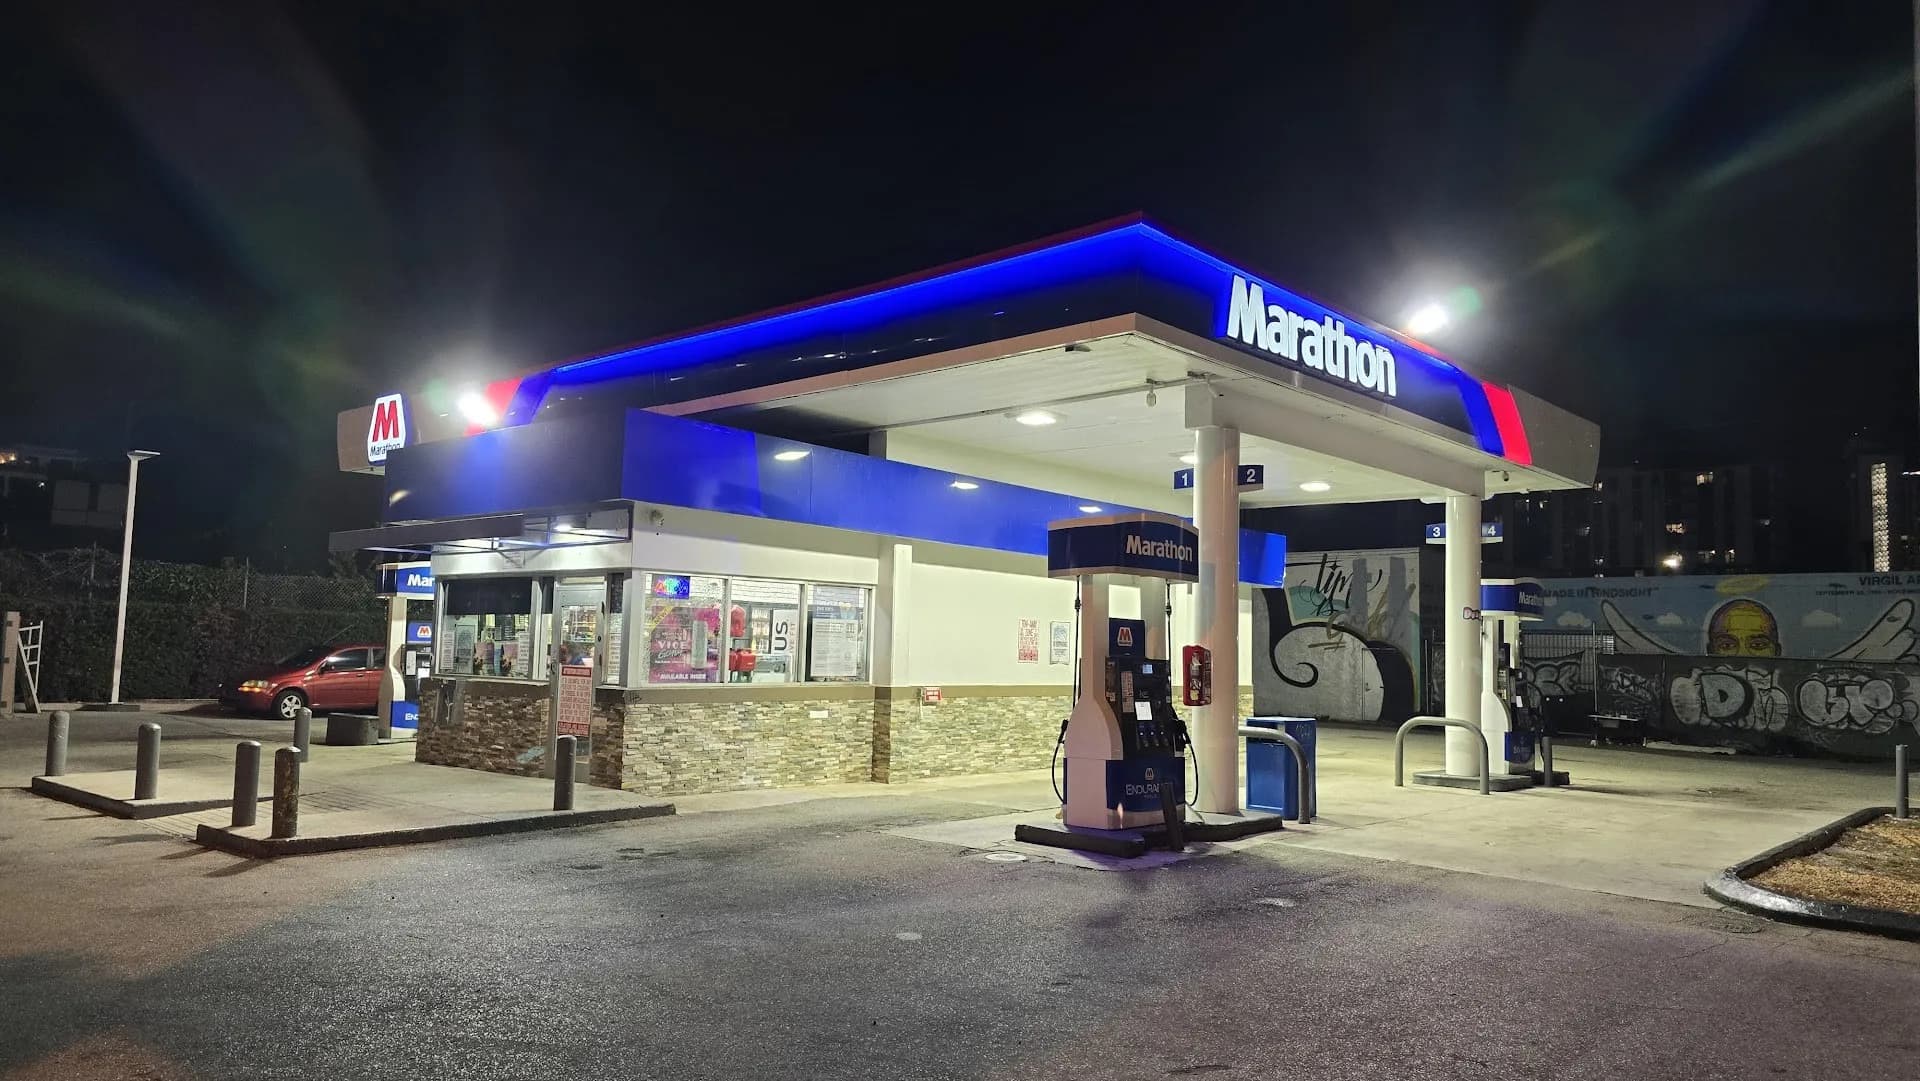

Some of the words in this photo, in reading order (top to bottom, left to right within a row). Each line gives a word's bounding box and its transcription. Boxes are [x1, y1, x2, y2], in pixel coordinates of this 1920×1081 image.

[1227, 274, 1396, 397] Marathon
[372, 400, 399, 442] M
[1181, 472, 1188, 487] 1
[1246, 468, 1256, 483] 2
[1432, 526, 1441, 537] 3
[1487, 525, 1496, 536] 4
[1125, 534, 1193, 562] Marathon
[1859, 575, 1903, 586] VIRGIL
[1519, 591, 1543, 606] Marat
[1120, 629, 1130, 640] M
[658, 640, 687, 650] VICE
[1125, 784, 1160, 796] ENDURAN
